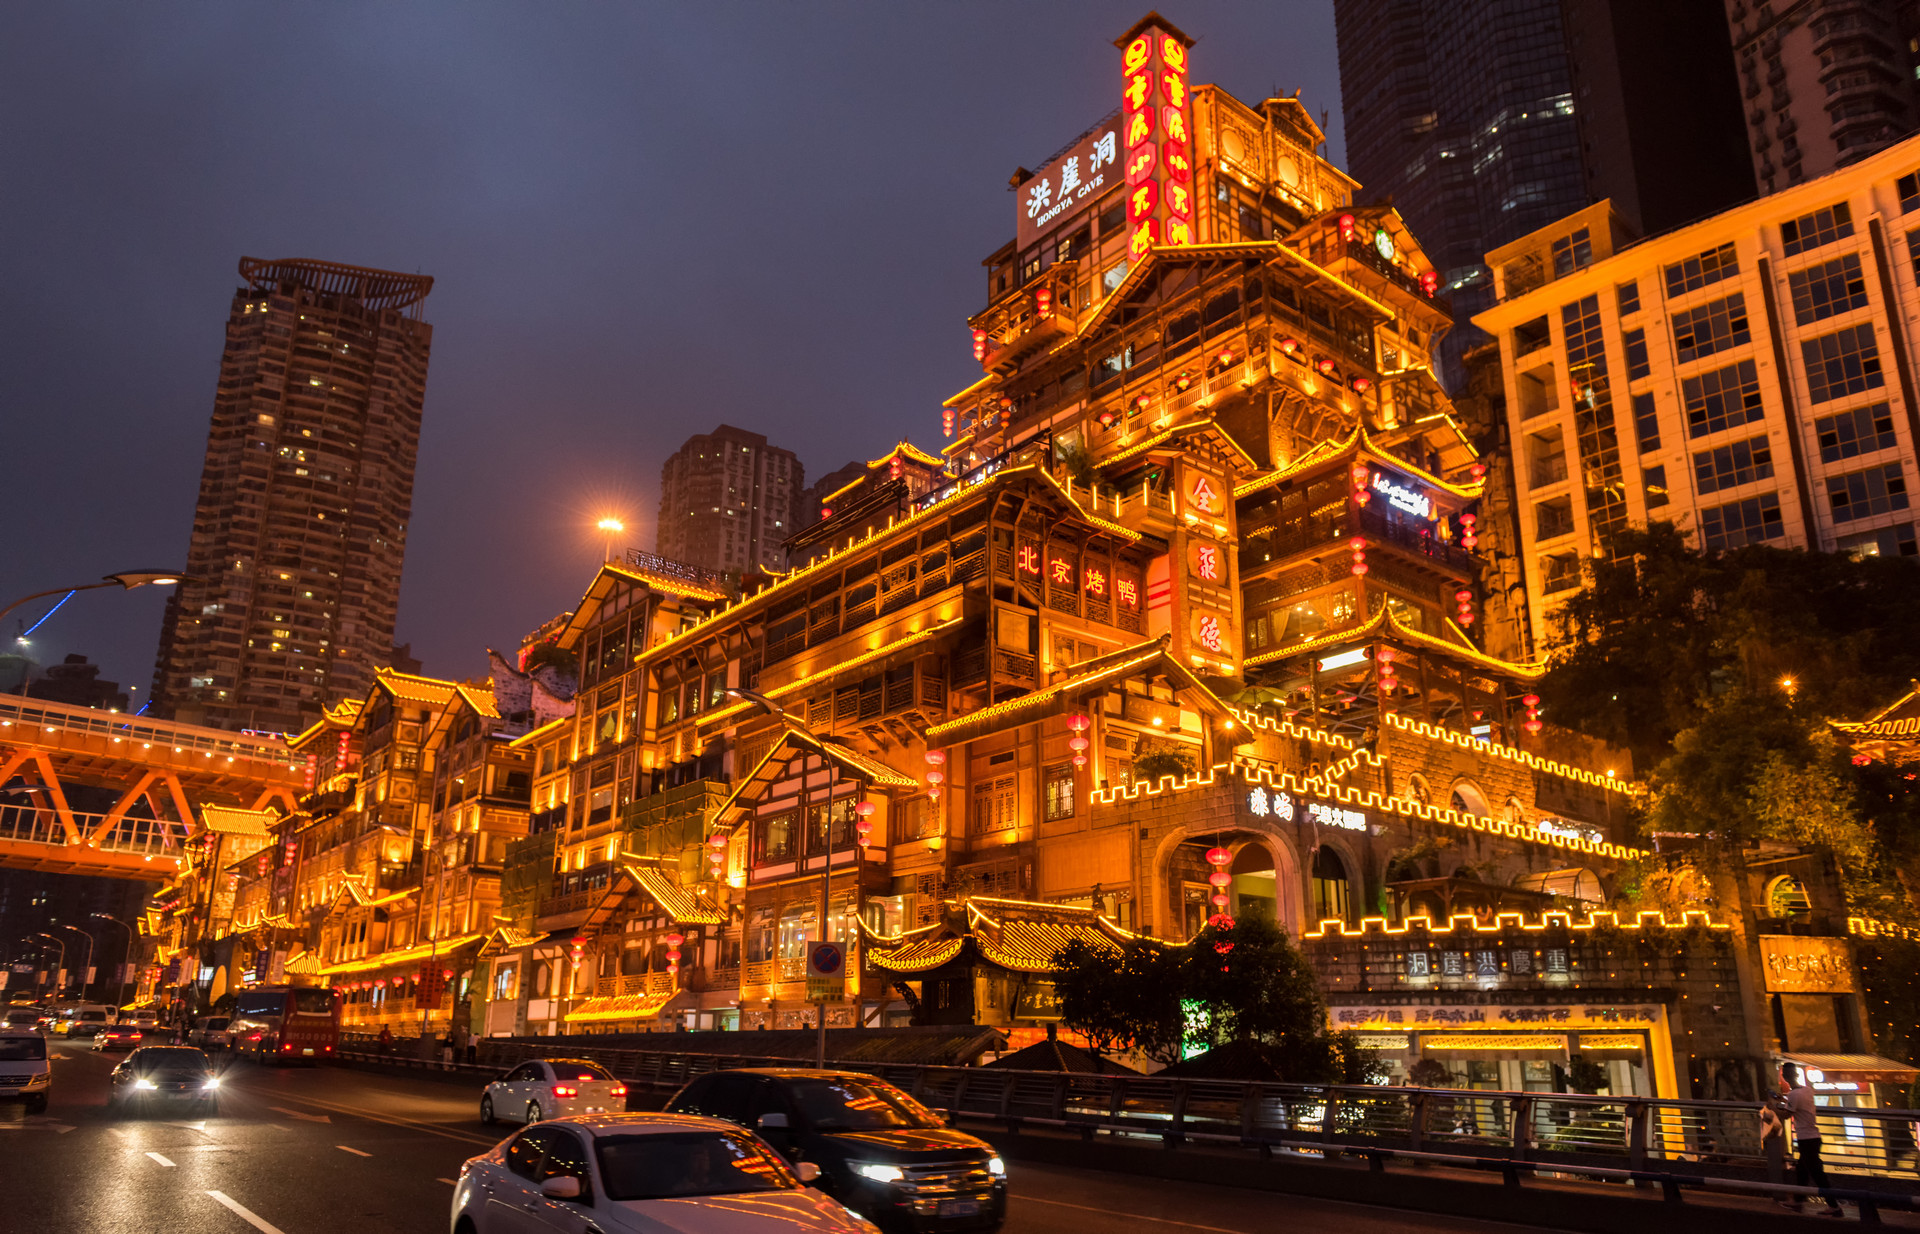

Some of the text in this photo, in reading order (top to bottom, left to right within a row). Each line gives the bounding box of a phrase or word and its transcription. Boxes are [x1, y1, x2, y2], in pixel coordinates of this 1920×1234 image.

[1026, 130, 1116, 218] 洪崖洞
[1036, 173, 1104, 228] HONGYA CAVE
[1018, 545, 1137, 606] 北京烤鸭
[1193, 477, 1222, 652] 全聚德
